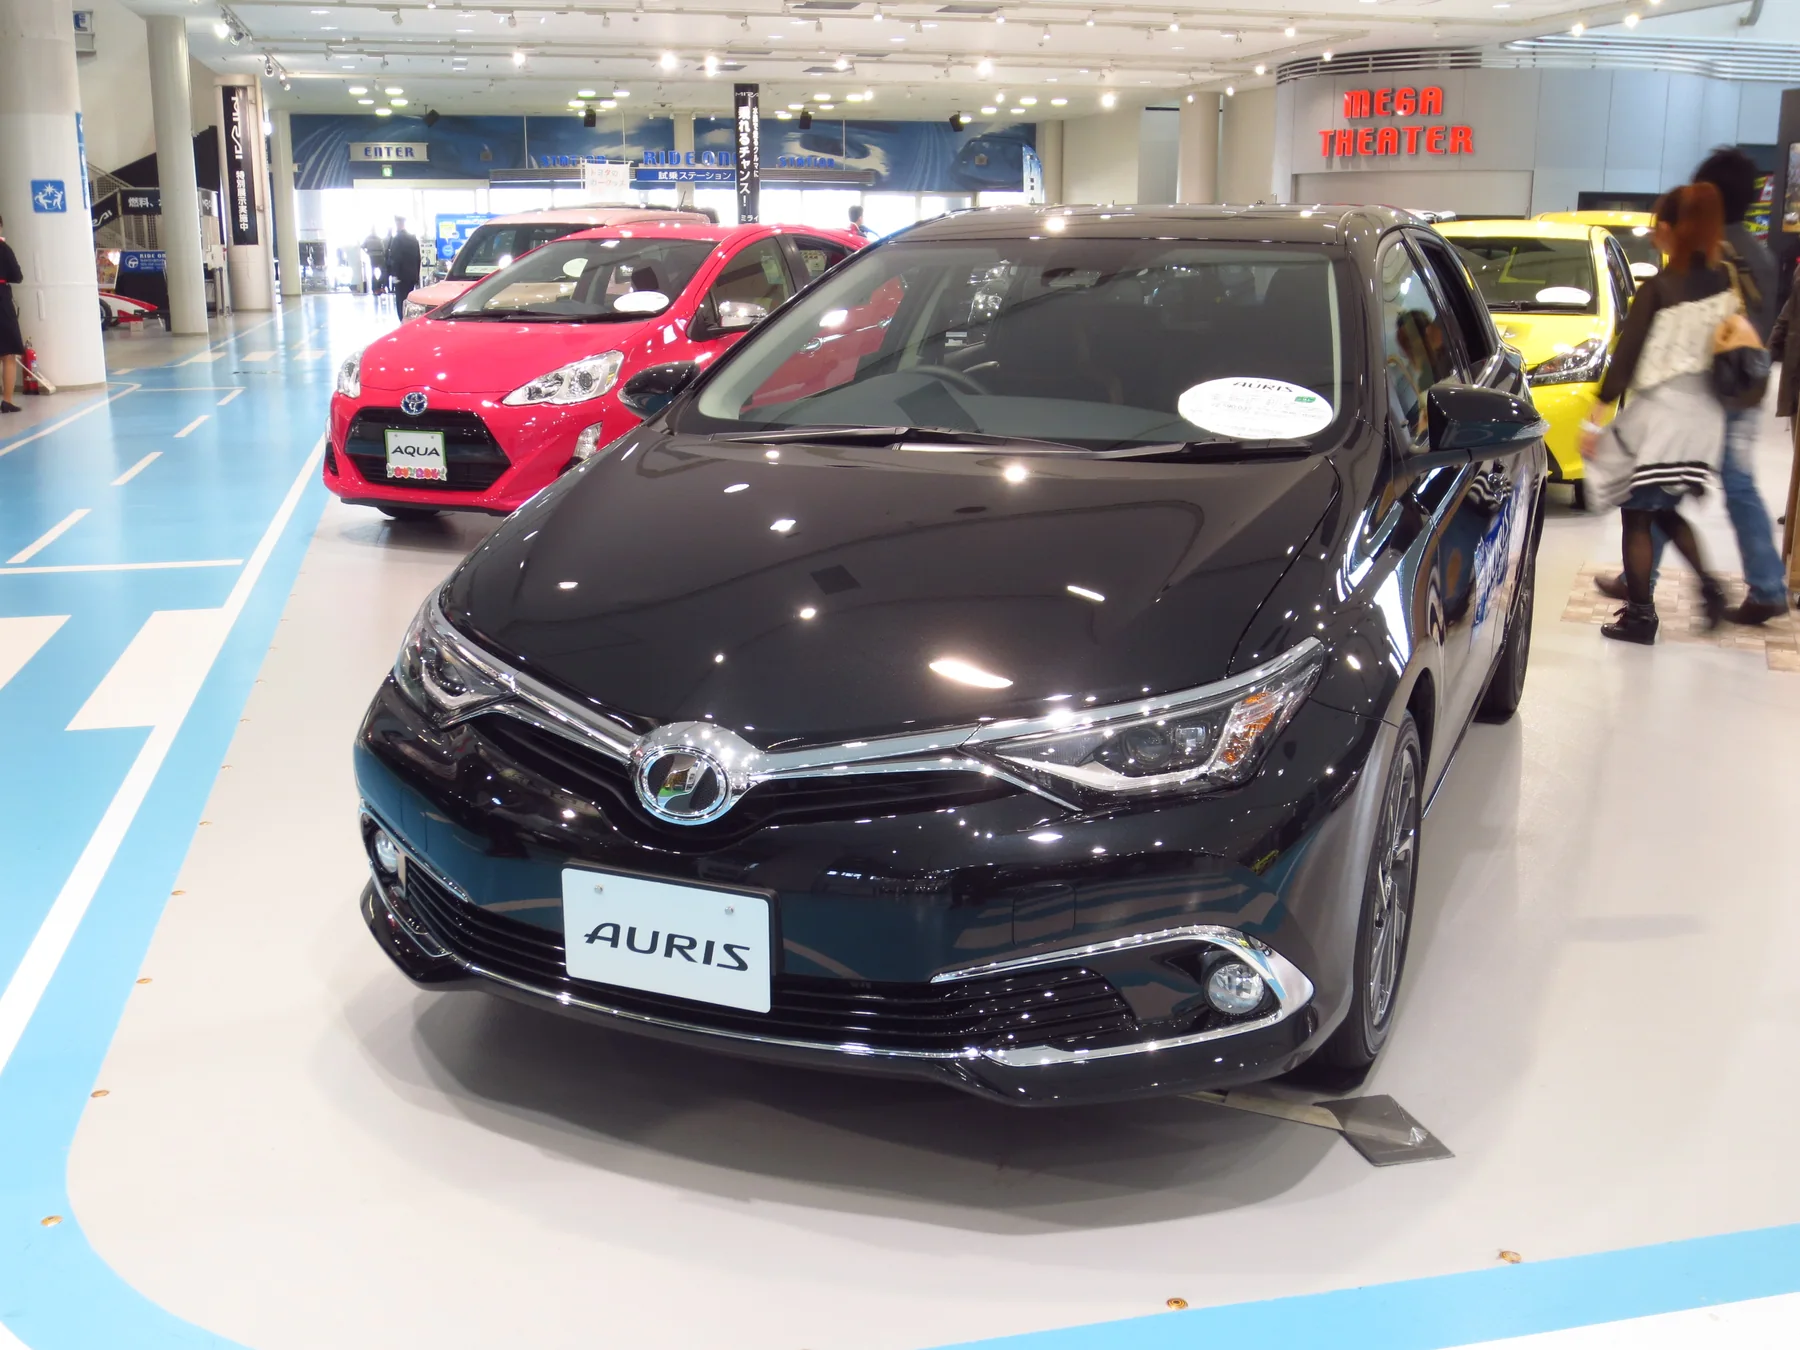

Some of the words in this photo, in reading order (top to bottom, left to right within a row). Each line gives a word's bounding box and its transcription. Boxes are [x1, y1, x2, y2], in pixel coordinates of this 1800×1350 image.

[1343, 86, 1444, 119] MEGA
[1318, 125, 1475, 157] THEATER
[364, 146, 415, 157] ENTER
[643, 150, 696, 167] RIDE
[702, 150, 737, 167] ON
[658, 171, 732, 181] 試乗ステーション
[391, 445, 440, 457] AQUA
[584, 922, 750, 971] AURIS
